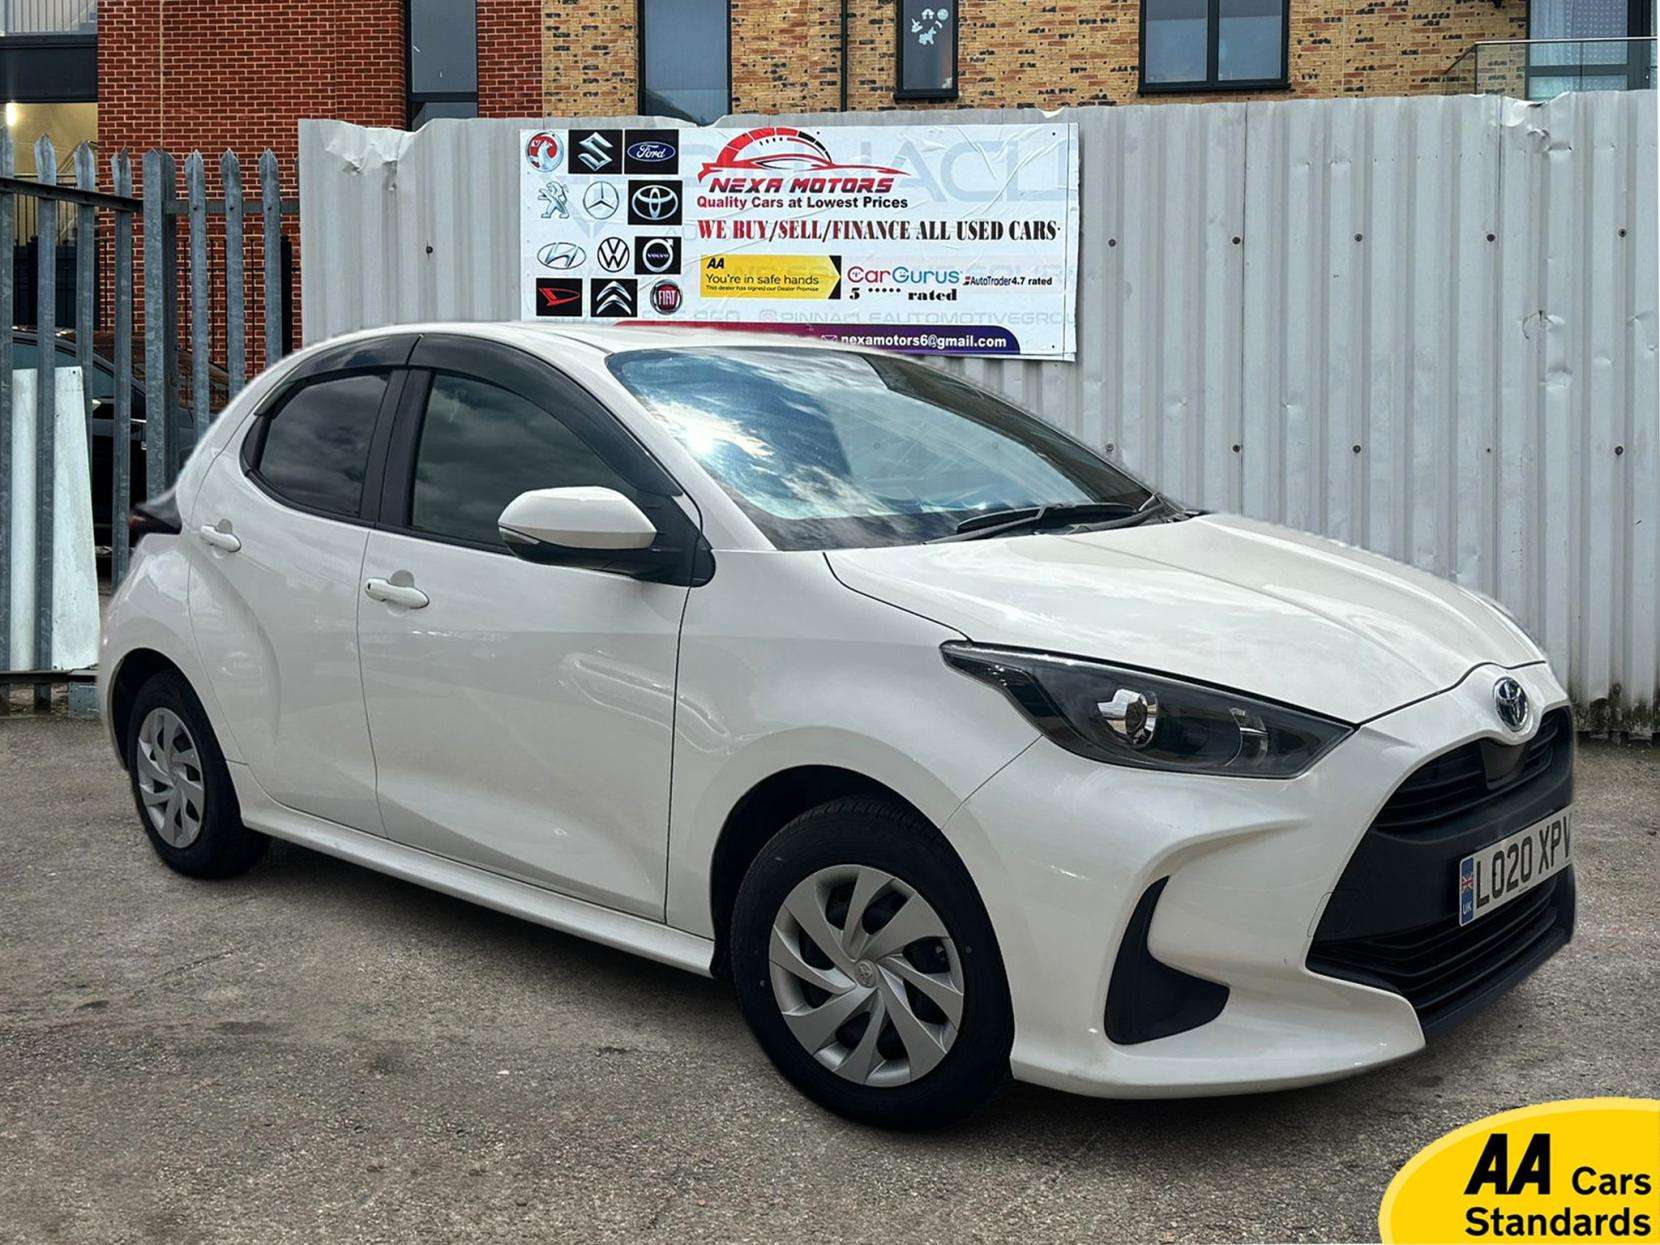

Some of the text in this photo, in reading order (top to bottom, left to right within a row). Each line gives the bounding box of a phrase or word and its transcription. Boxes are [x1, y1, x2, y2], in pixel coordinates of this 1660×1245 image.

[636, 144, 665, 158] Ford
[709, 178, 894, 194] NEXA MOTORS
[697, 196, 908, 210] Quality Cars at Lowest Prices
[697, 220, 727, 240] WE
[733, 220, 911, 242] BUY/SELL/FINANCE
[916, 220, 951, 240] ALL
[956, 220, 1004, 240] USED
[1009, 220, 1057, 240] CARS
[706, 258, 724, 269] AA
[706, 274, 820, 285] You're in safe hands
[847, 266, 960, 284] CarGurus
[1028, 276, 1052, 286] rated
[658, 290, 676, 306] FIAT
[849, 287, 958, 301] 5 rated
[841, 334, 1007, 349] nexamotors6@gmail.com
[1463, 901, 1473, 915] UK
